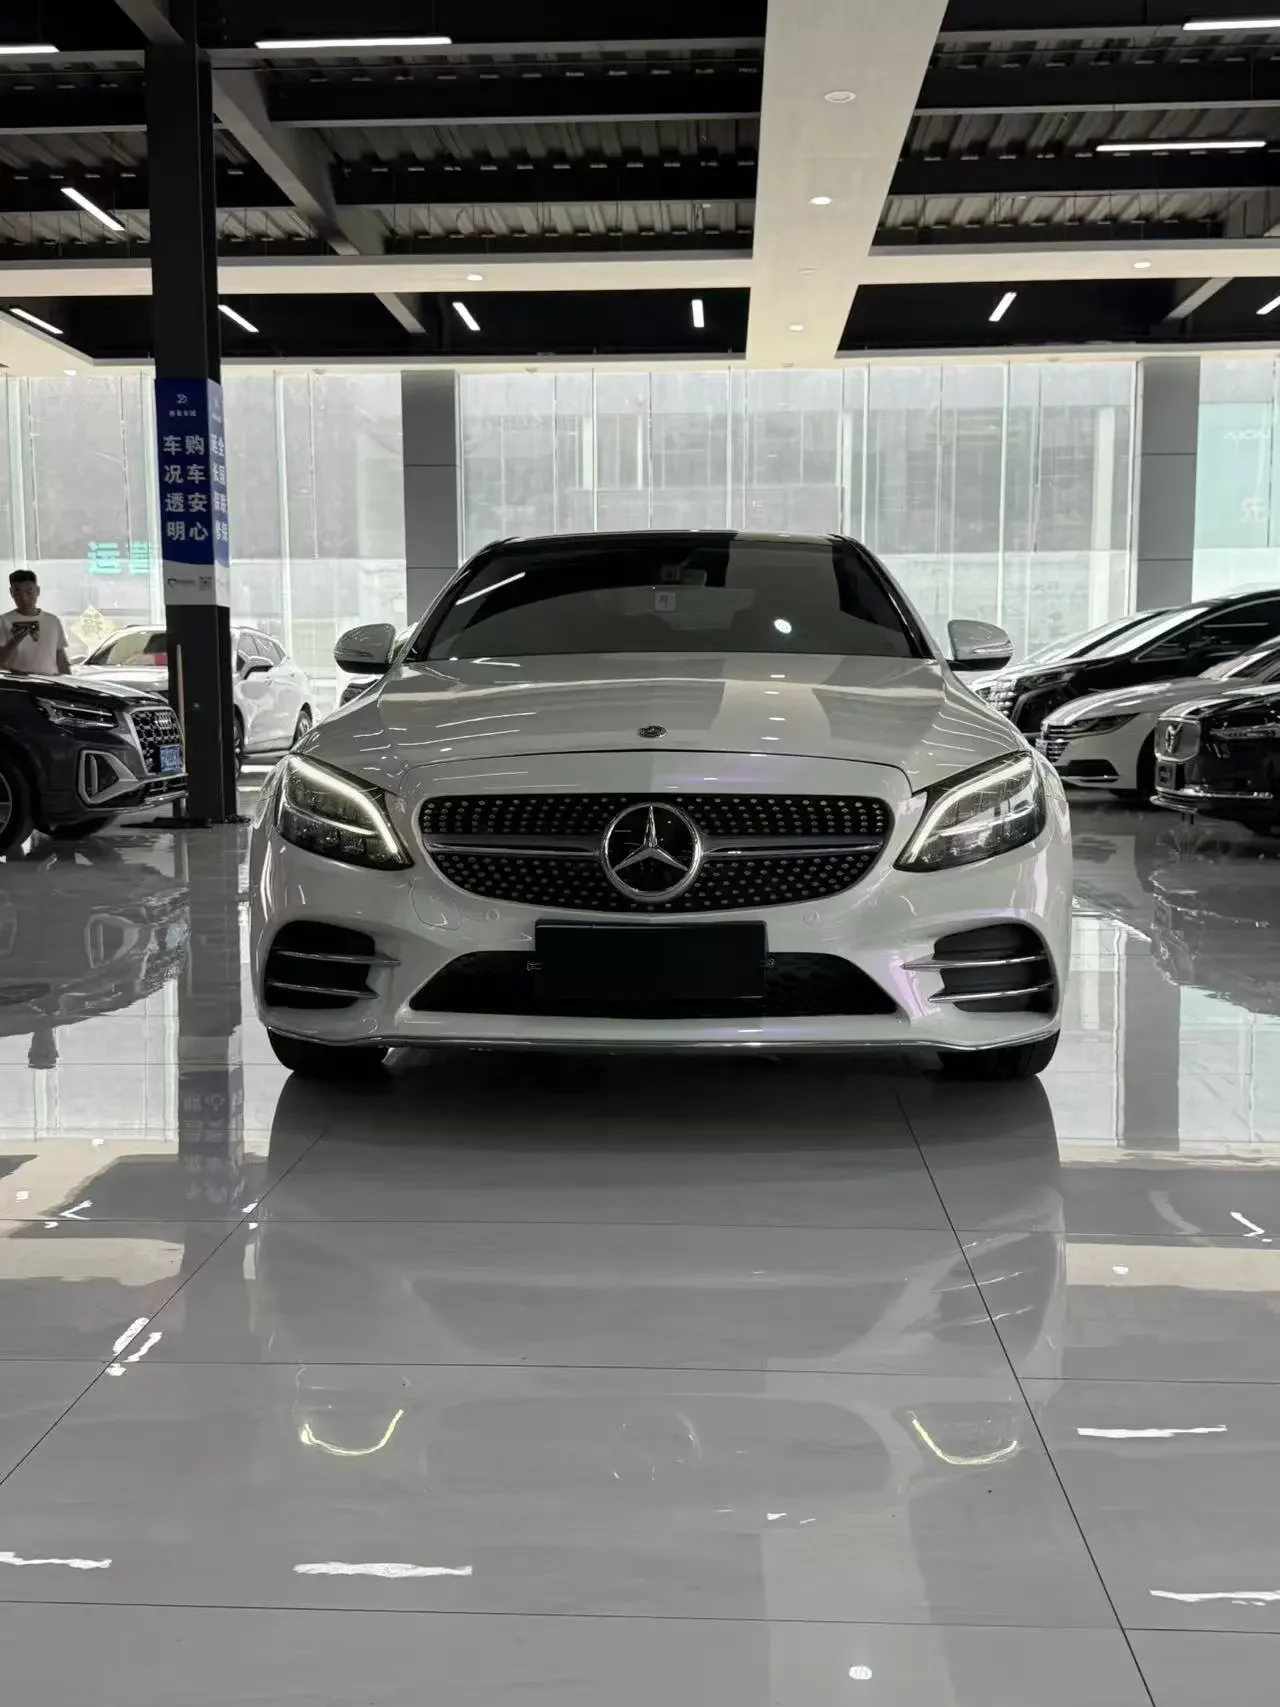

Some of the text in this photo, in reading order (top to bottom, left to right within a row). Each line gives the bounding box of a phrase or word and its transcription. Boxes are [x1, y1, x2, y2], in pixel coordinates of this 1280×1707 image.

[163, 434, 186, 541] 车况透明
[184, 434, 209, 541] 购车安心
